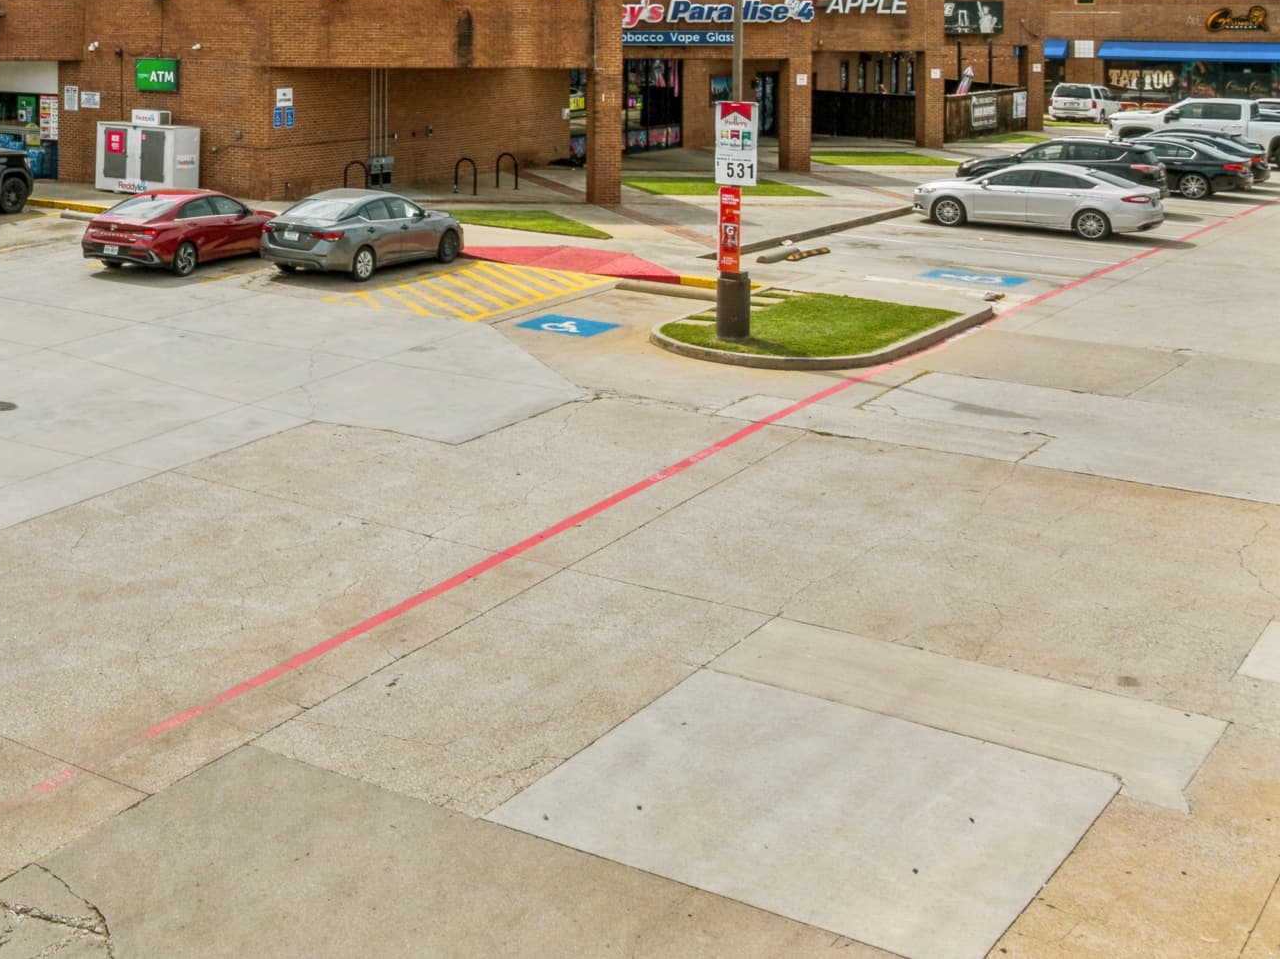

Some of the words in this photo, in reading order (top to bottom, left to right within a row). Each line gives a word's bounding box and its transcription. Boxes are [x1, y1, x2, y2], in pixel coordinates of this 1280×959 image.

[798, 0, 814, 22] 4
[622, 32, 664, 42] obacco
[670, 32, 700, 45] Vape
[149, 71, 174, 82] ATM
